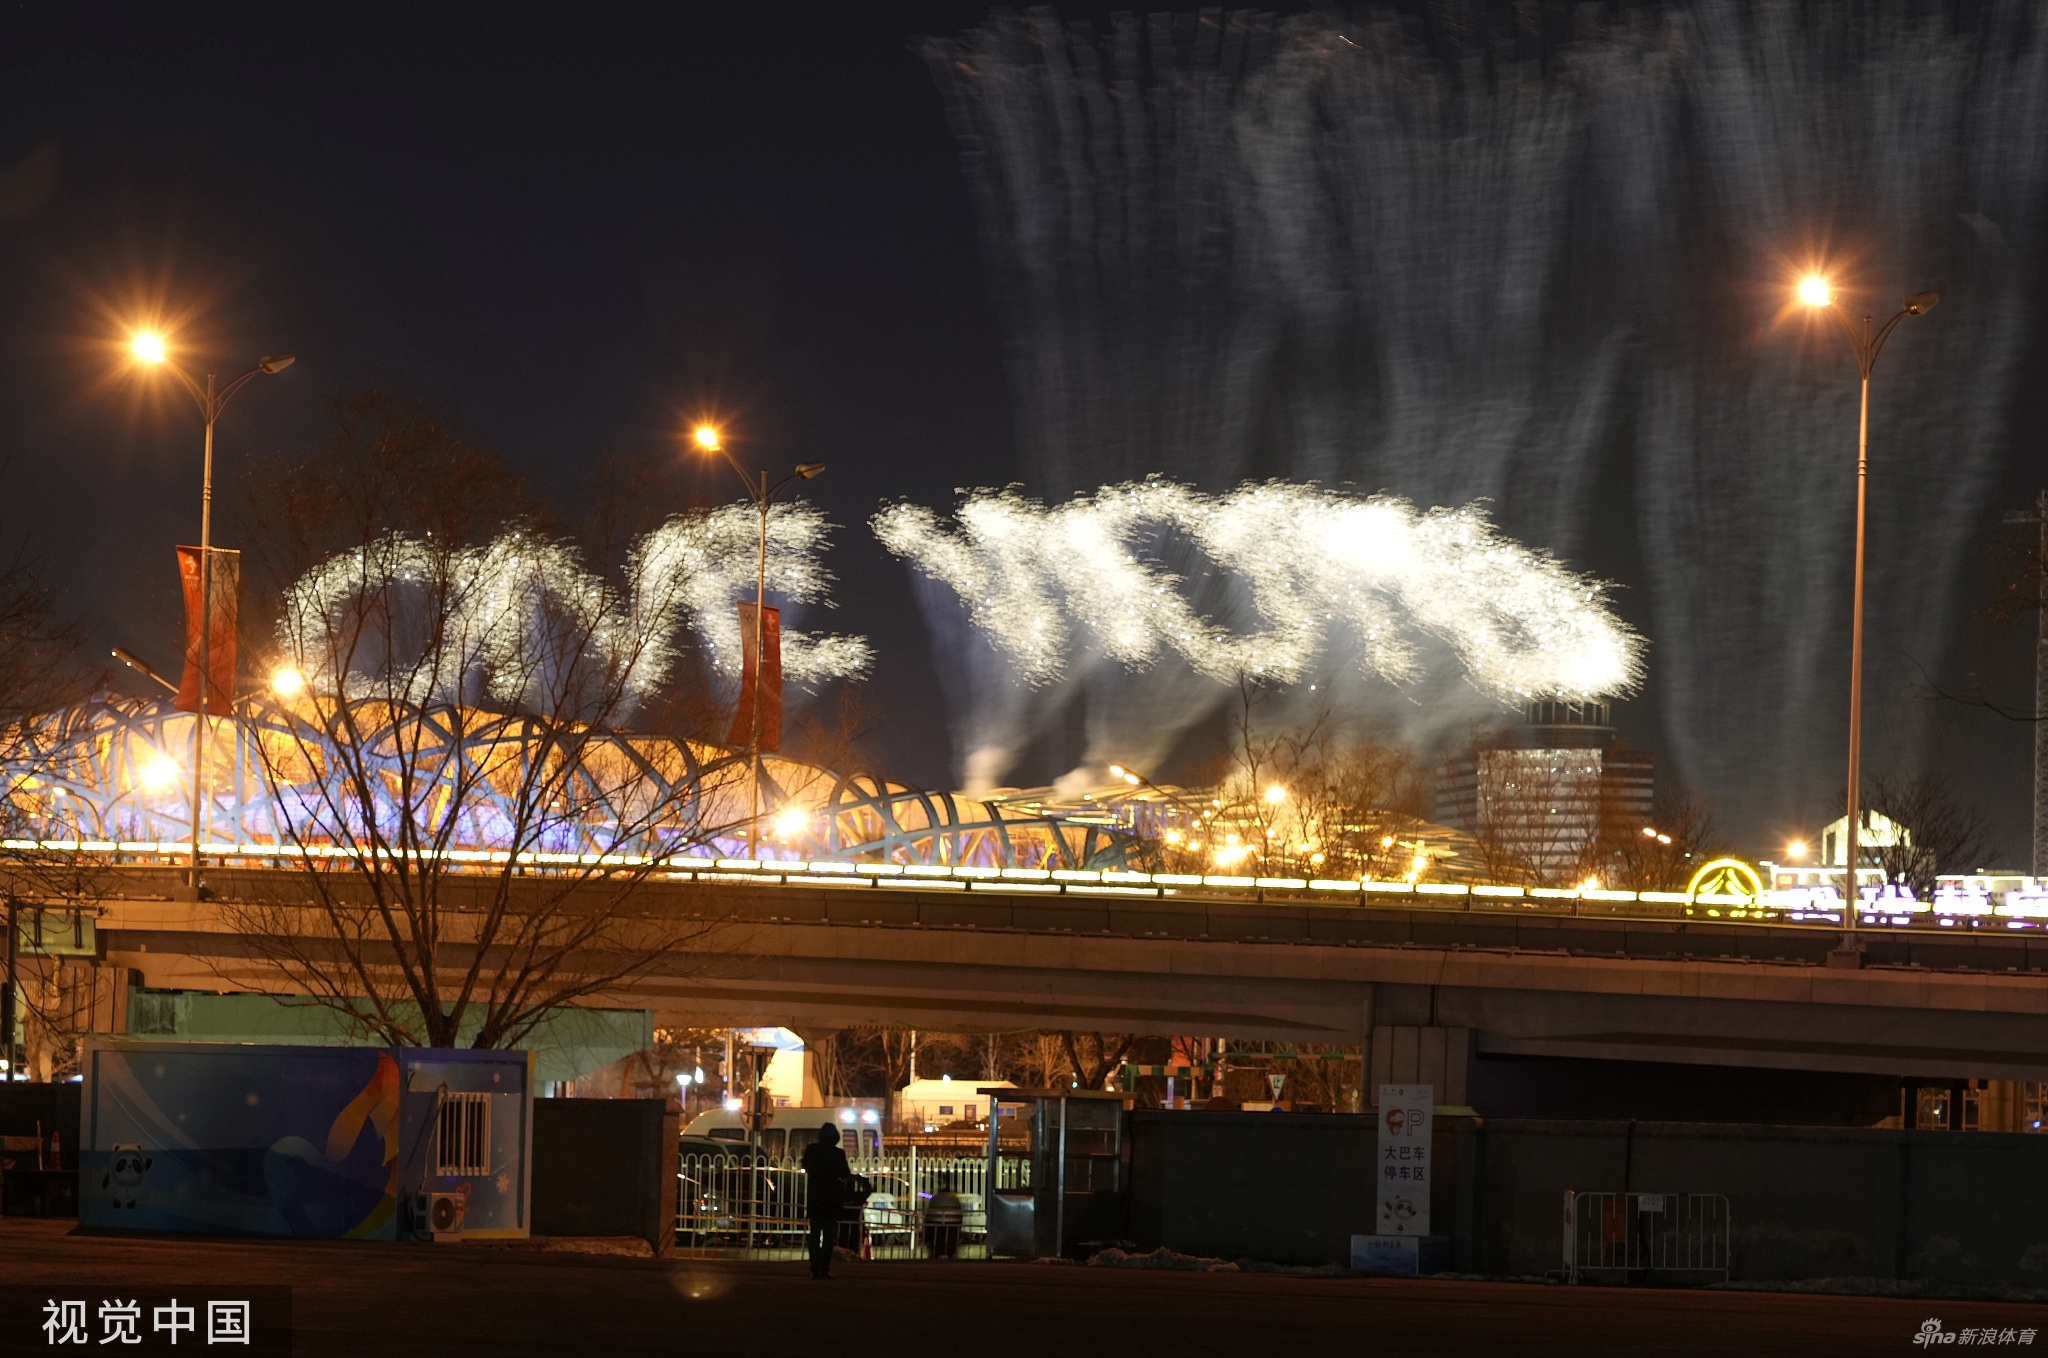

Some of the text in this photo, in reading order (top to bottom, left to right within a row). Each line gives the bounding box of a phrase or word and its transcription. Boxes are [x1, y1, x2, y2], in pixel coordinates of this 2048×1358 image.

[1407, 1108, 1425, 1136] P
[1384, 1145, 1425, 1161] 大巴车
[1384, 1165, 1425, 1181] 停车区
